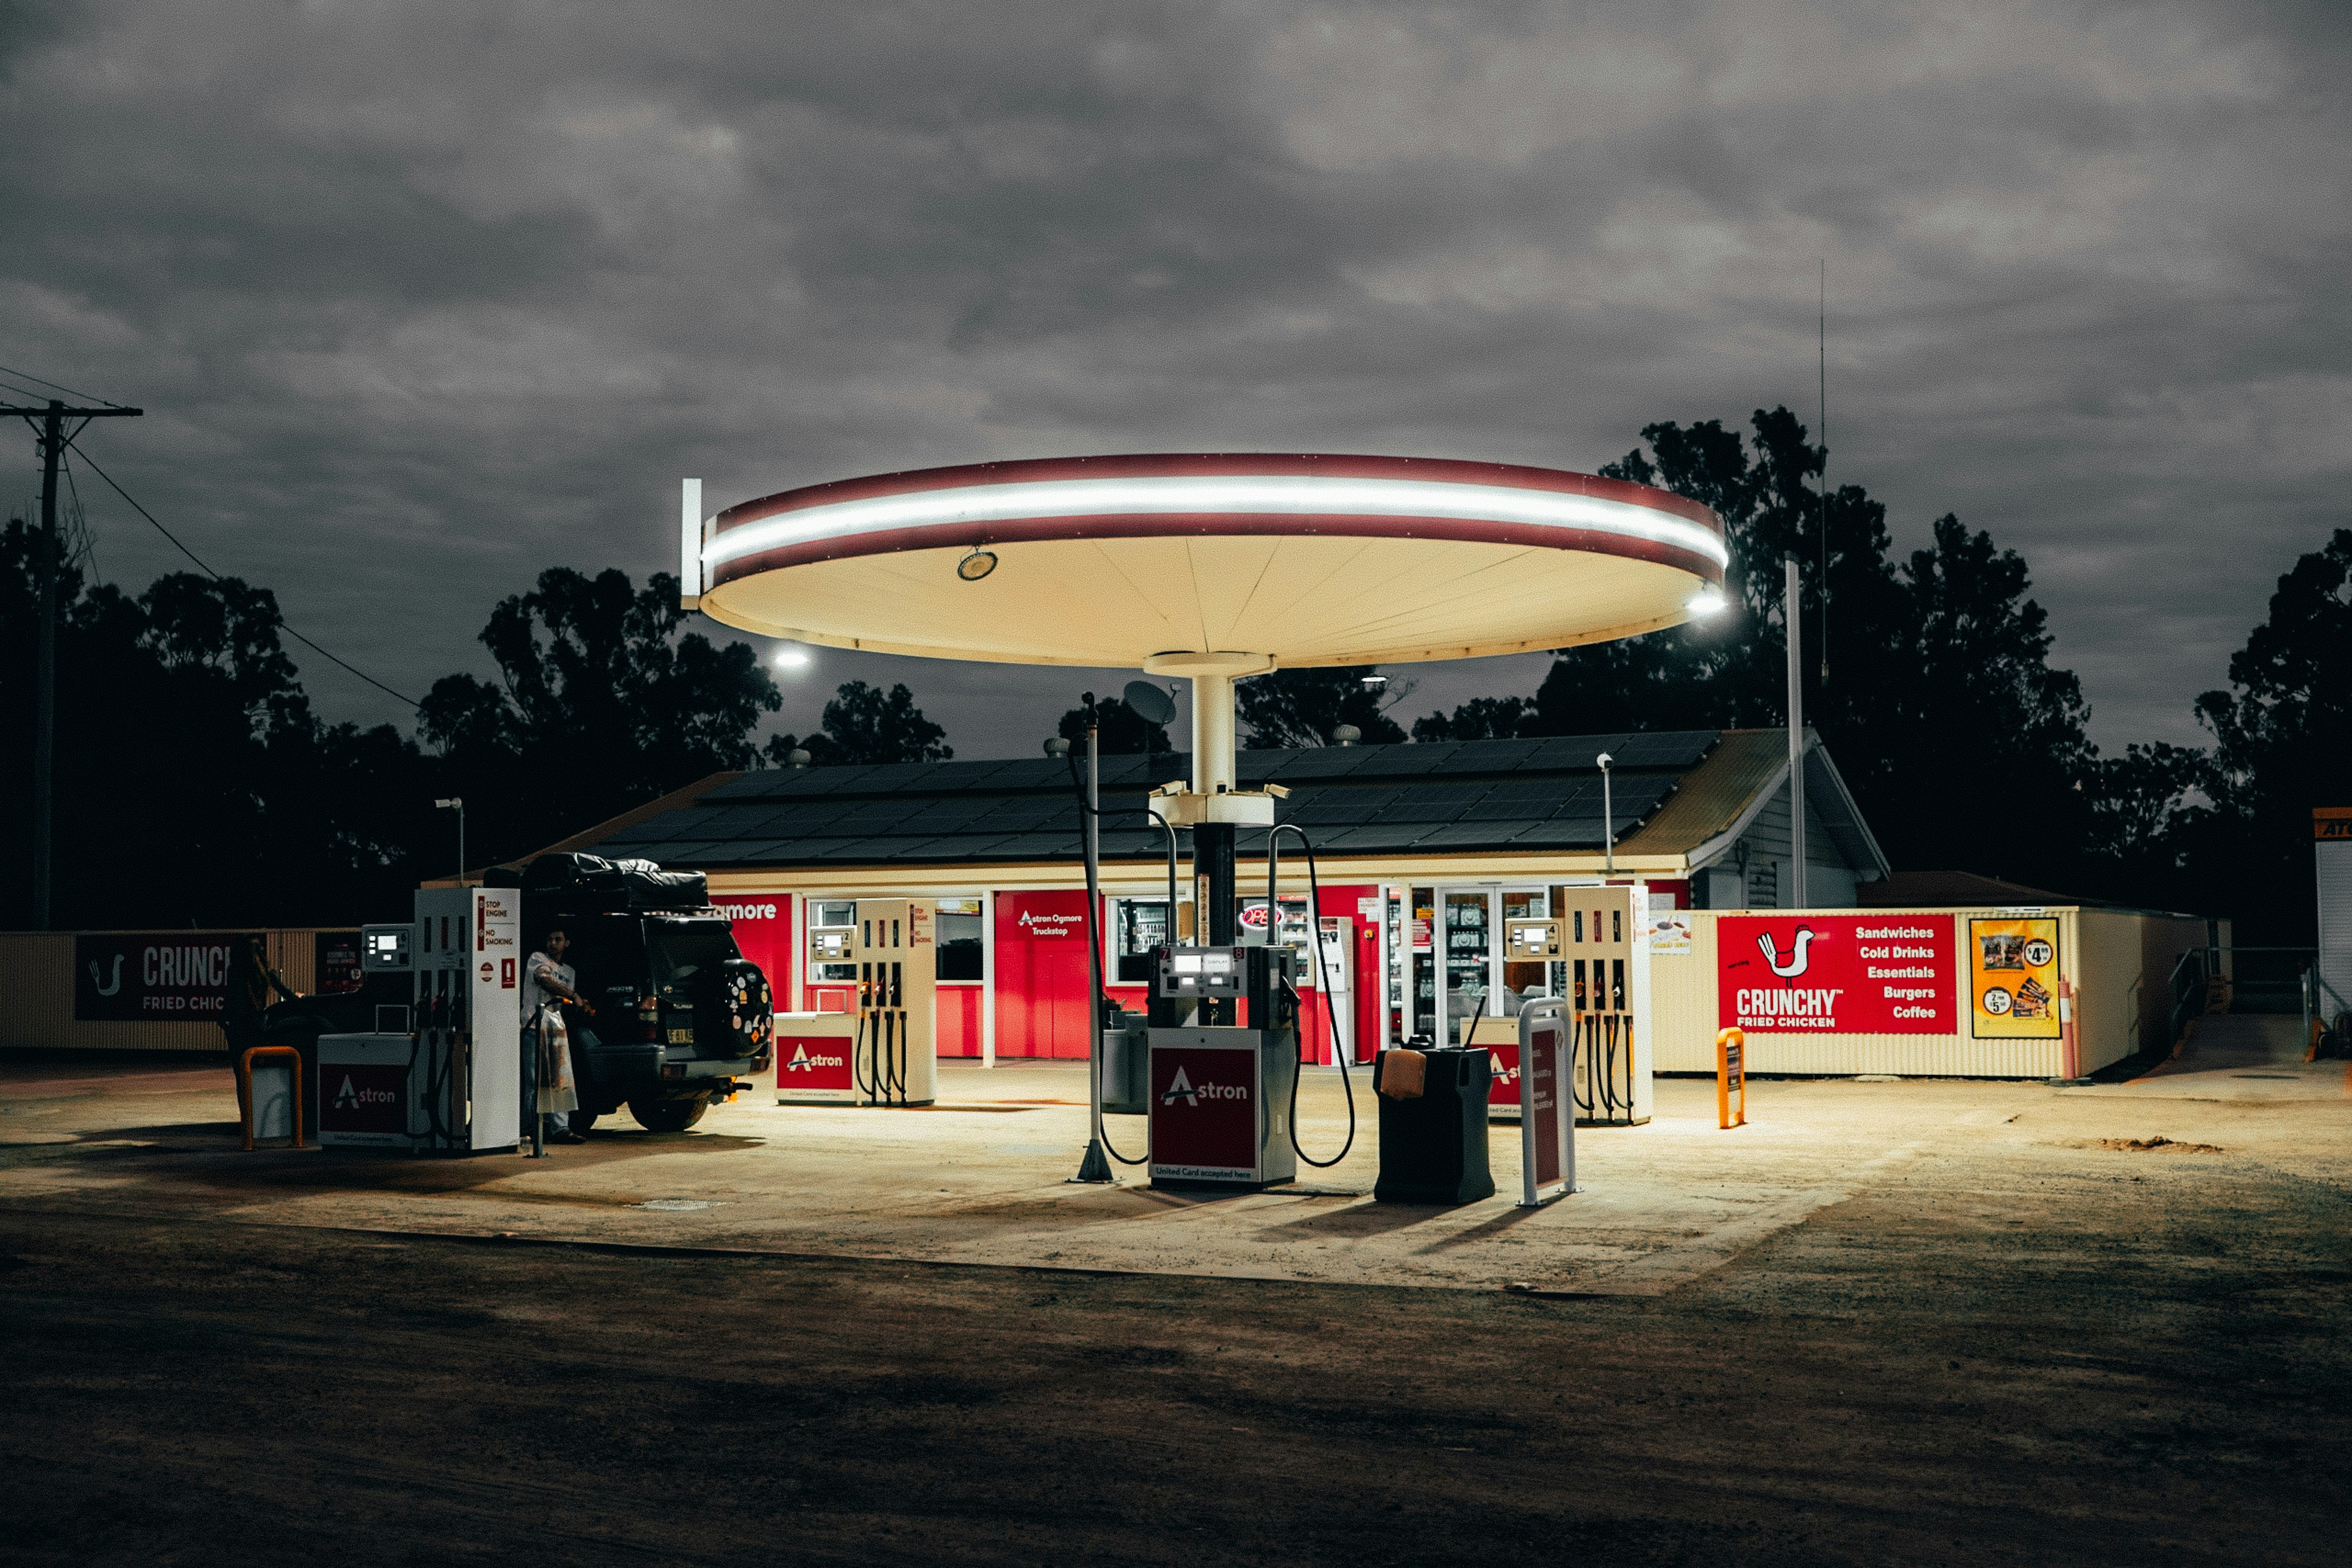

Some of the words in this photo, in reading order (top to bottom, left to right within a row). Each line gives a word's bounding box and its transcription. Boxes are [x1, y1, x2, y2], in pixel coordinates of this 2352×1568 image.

[1018, 910, 1051, 927] Astron
[1052, 914, 1083, 925] Ogmore
[1032, 927, 1068, 937] Truckstop
[1549, 925, 1555, 934] 4
[1855, 926, 1935, 940] Sandwiches
[1161, 949, 1170, 959] 7
[1235, 948, 1242, 958] 8
[1860, 946, 1890, 959] Cold
[1892, 946, 1935, 959] Drinks
[1867, 965, 1936, 979] Essentials
[1883, 986, 1936, 1001] Burgers
[143, 996, 185, 1009] FRIED
[1893, 1005, 1937, 1019] Coffee
[1736, 1017, 1775, 1027] FRIED
[1777, 1017, 1836, 1028] CHICKEN
[787, 1043, 844, 1072] Astron
[332, 1074, 395, 1109] Astron
[1161, 1065, 1248, 1106] Astron
[1201, 1171, 1232, 1179] accepted
